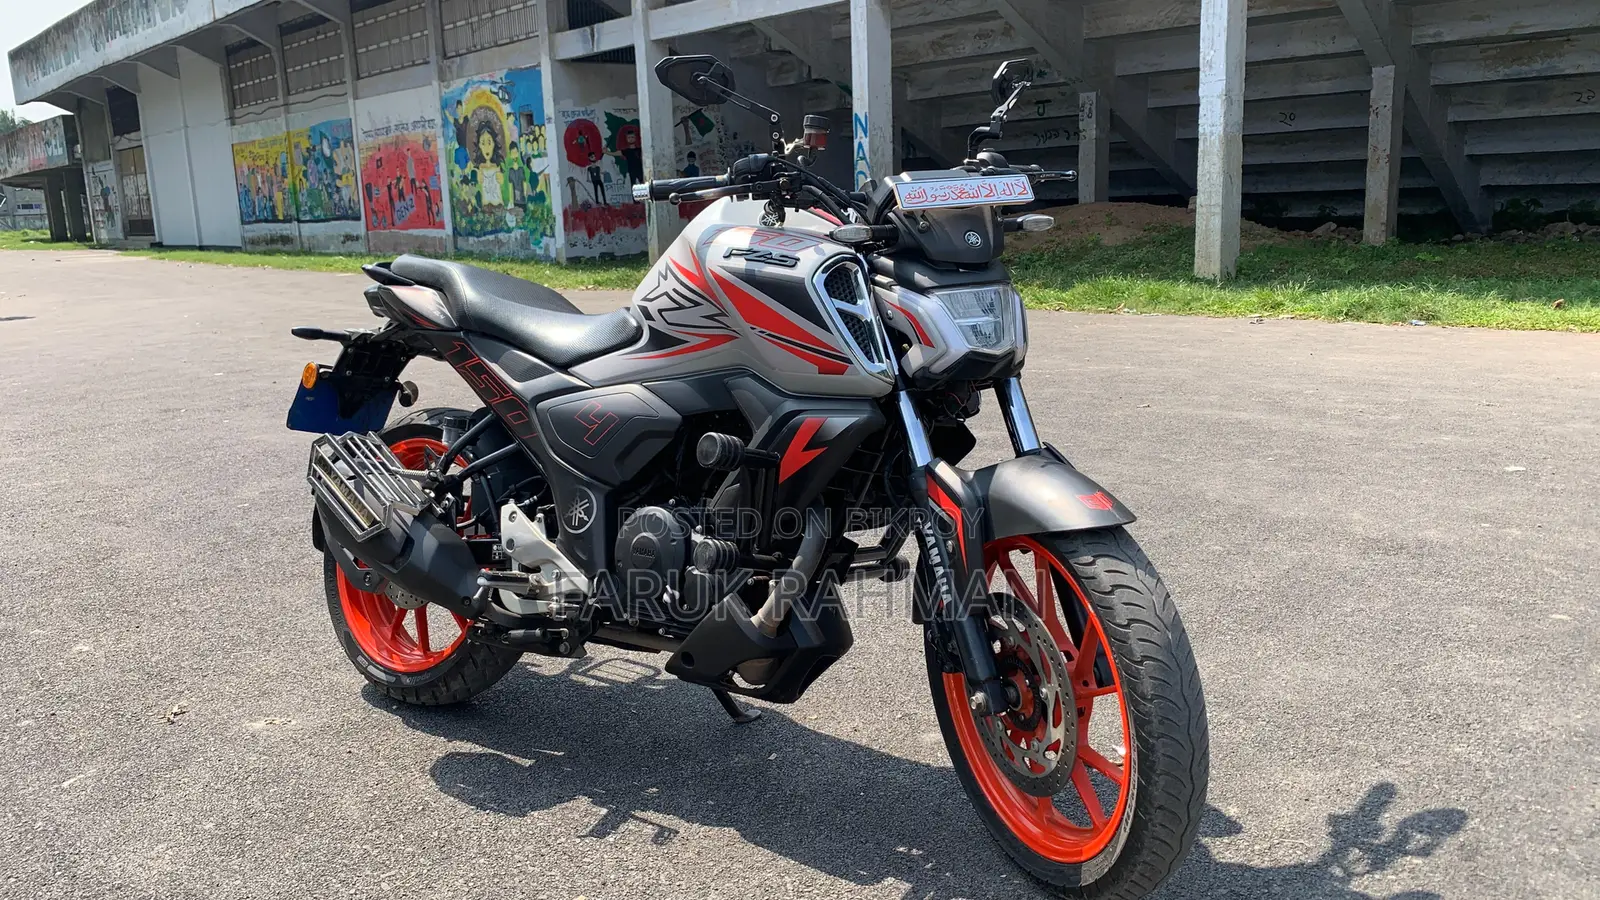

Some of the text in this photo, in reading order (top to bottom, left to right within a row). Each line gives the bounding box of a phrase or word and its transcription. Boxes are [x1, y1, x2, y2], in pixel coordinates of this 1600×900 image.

[444, 340, 540, 439] 150
[574, 401, 620, 446] 4
[923, 521, 952, 606] YAMAHA
